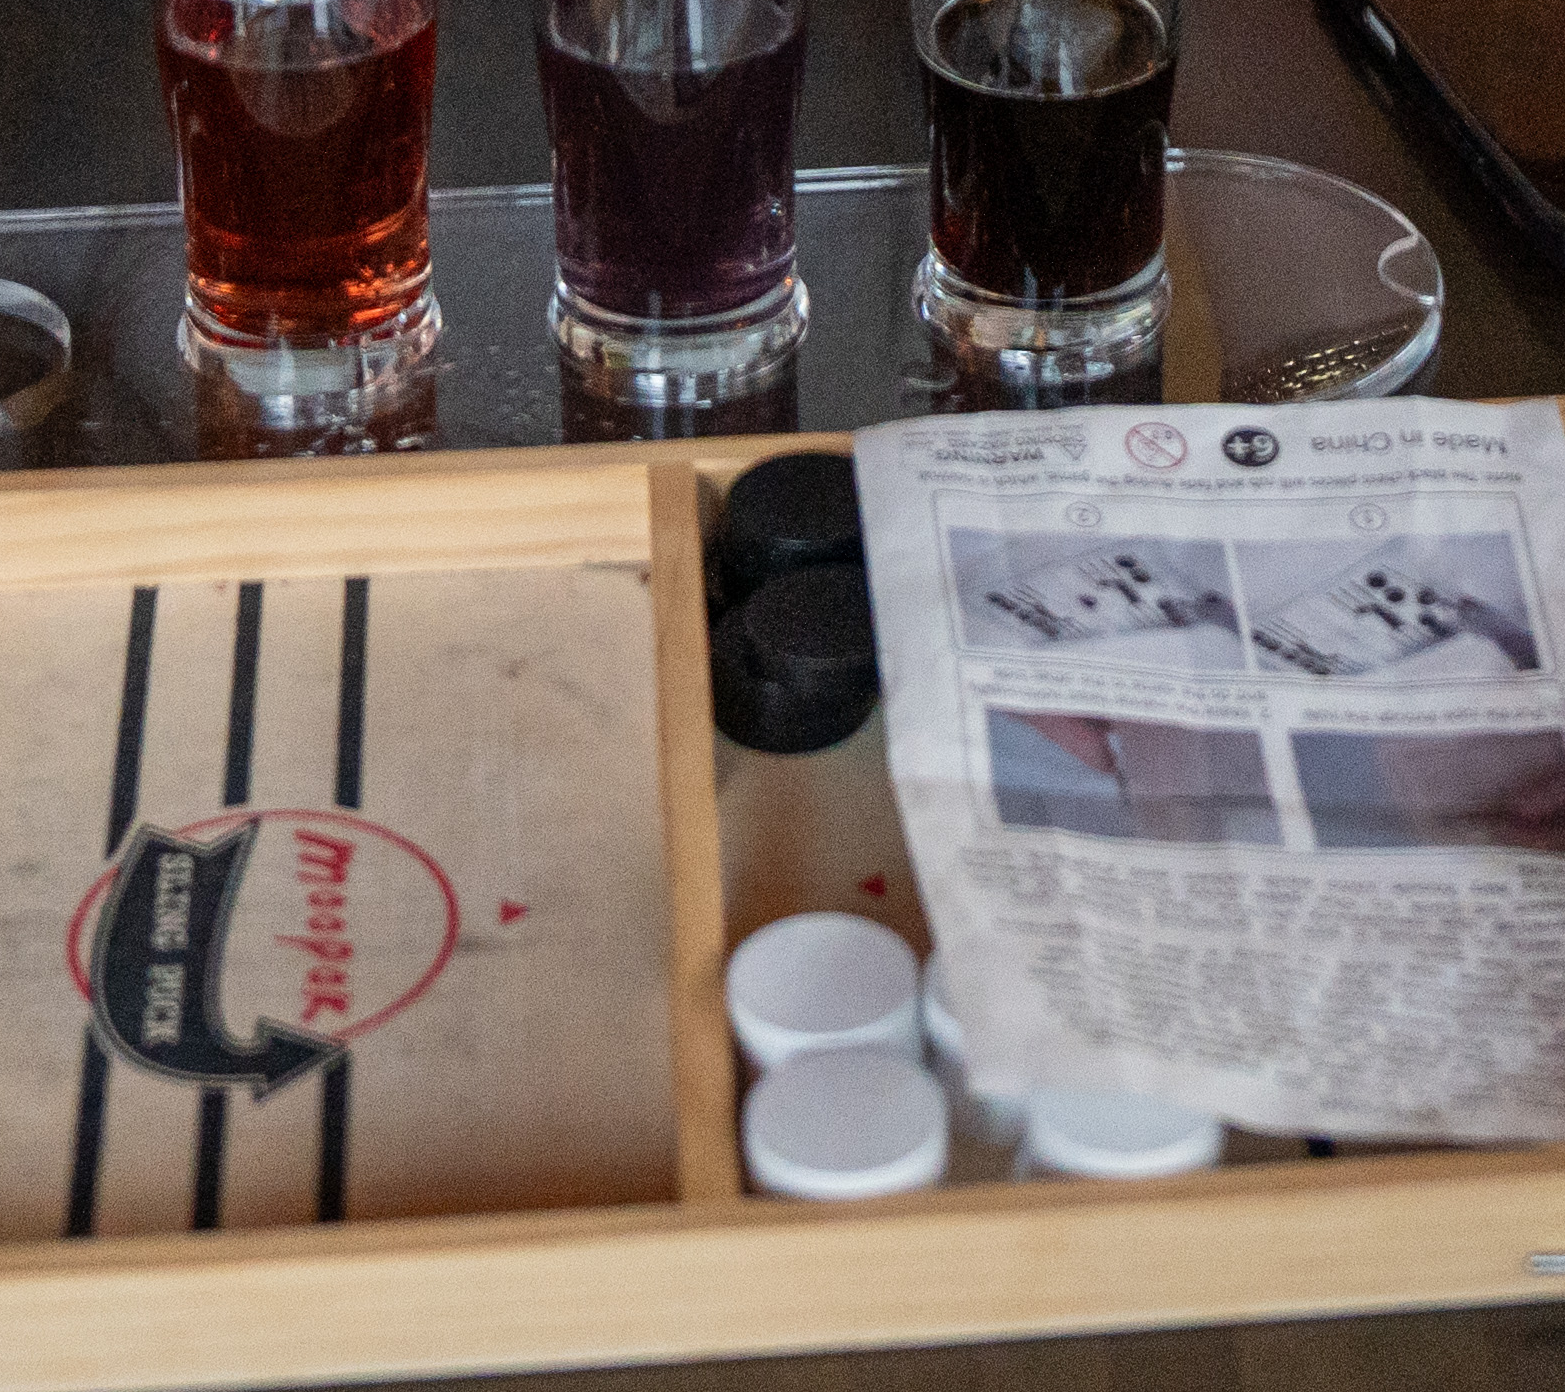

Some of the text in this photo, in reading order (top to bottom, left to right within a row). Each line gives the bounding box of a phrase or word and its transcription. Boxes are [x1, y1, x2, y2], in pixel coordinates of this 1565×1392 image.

[1228, 434, 1273, 462] 6+
[1310, 428, 1508, 454] Made in China
[141, 851, 195, 1045] SLING PUCK
